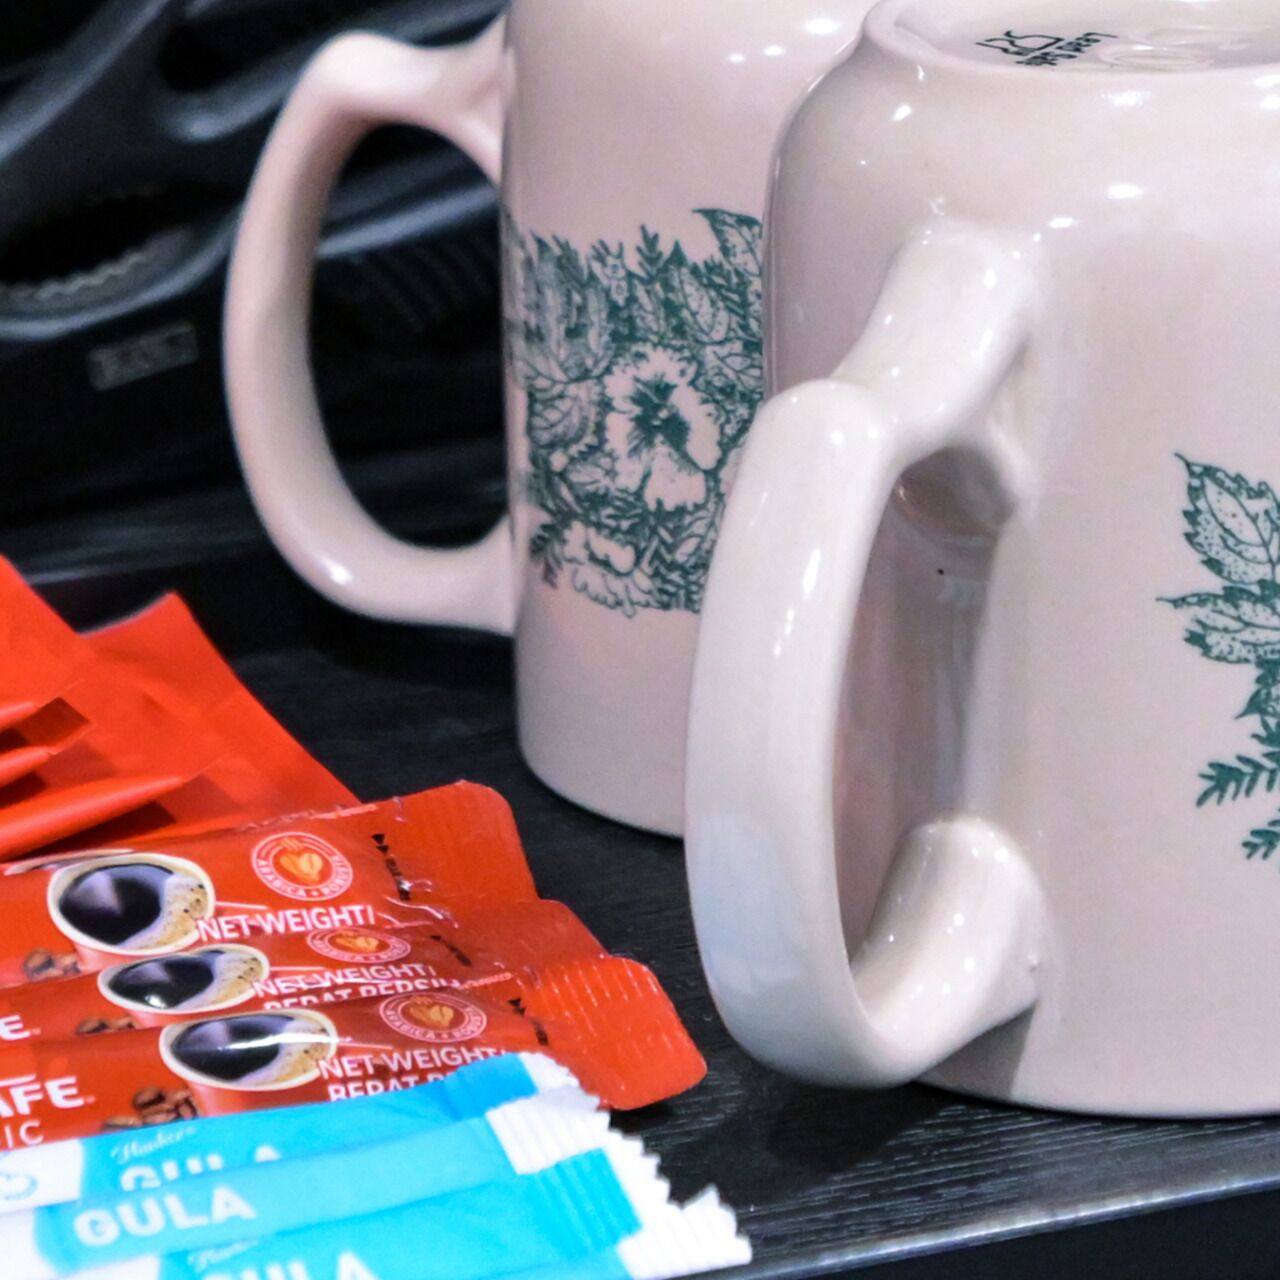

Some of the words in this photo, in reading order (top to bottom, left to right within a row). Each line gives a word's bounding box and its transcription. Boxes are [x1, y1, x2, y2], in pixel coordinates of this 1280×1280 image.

[197, 913, 251, 942] NET
[251, 974, 309, 998] NET
[319, 1053, 375, 1080] NET
[73, 1185, 258, 1247] GULA
